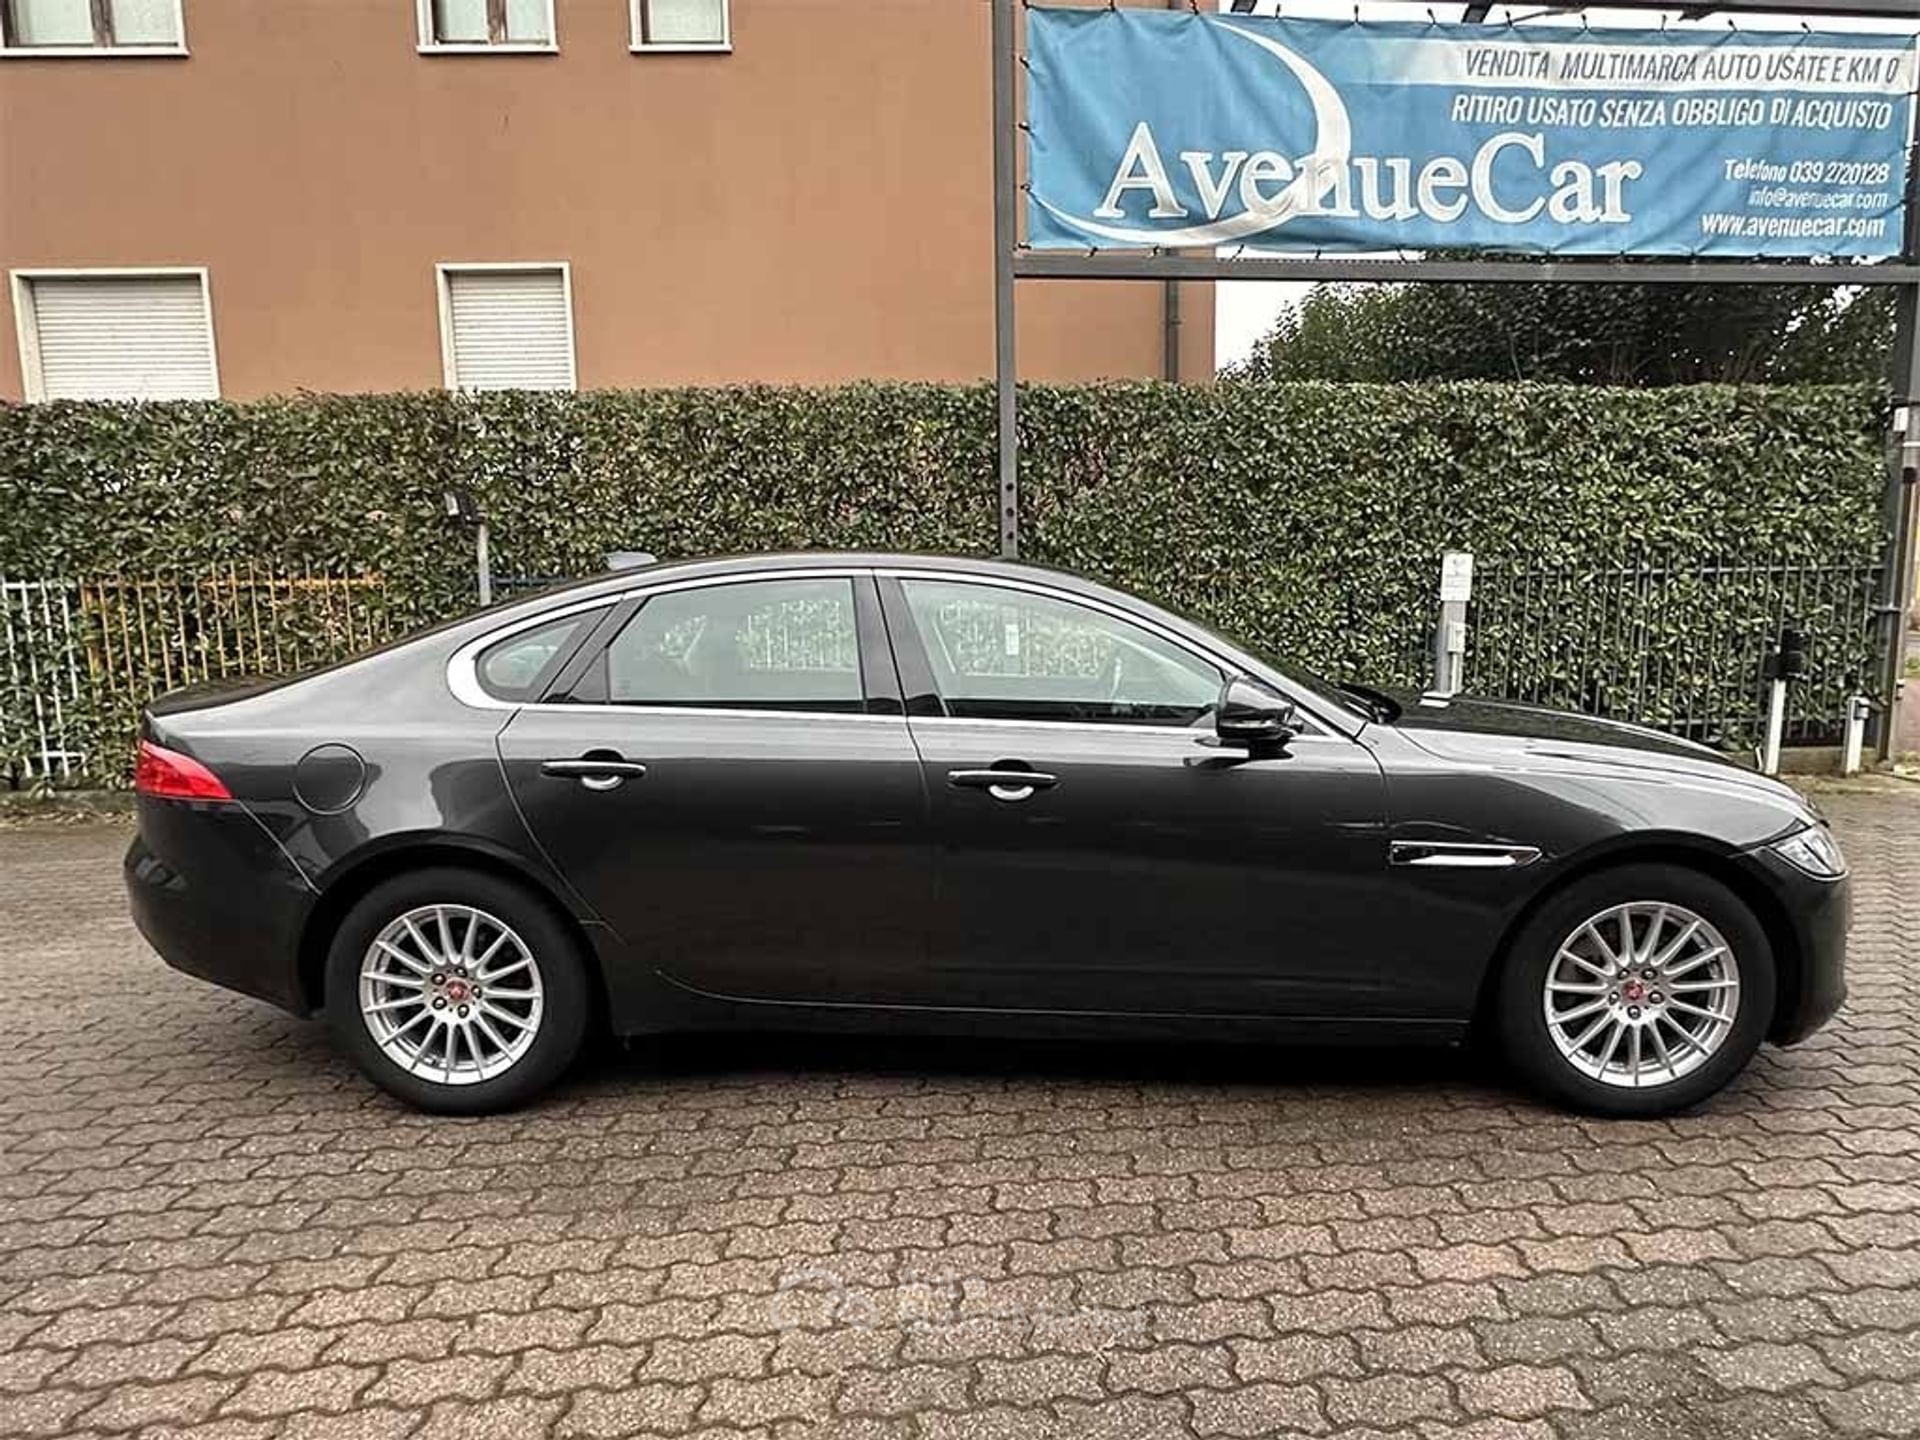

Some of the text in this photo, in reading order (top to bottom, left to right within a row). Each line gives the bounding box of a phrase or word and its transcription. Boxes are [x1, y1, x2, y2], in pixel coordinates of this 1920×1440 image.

[1466, 49, 1549, 77] VENDITA
[1560, 52, 1697, 81] MULTIMARCA
[1703, 54, 1761, 81] AUTO
[1766, 54, 1829, 82] USATE
[1832, 56, 1845, 82] E
[1849, 57, 1881, 82] KM
[1451, 94, 1892, 130] RITIRO USATO SENZA OBBLIGO DI ACQUISTO
[1094, 122, 1642, 224] AvenueCar
[1725, 158, 1787, 182] Telefono
[1789, 162, 1824, 183] 039
[1749, 187, 1888, 209] info@avenuecar.com
